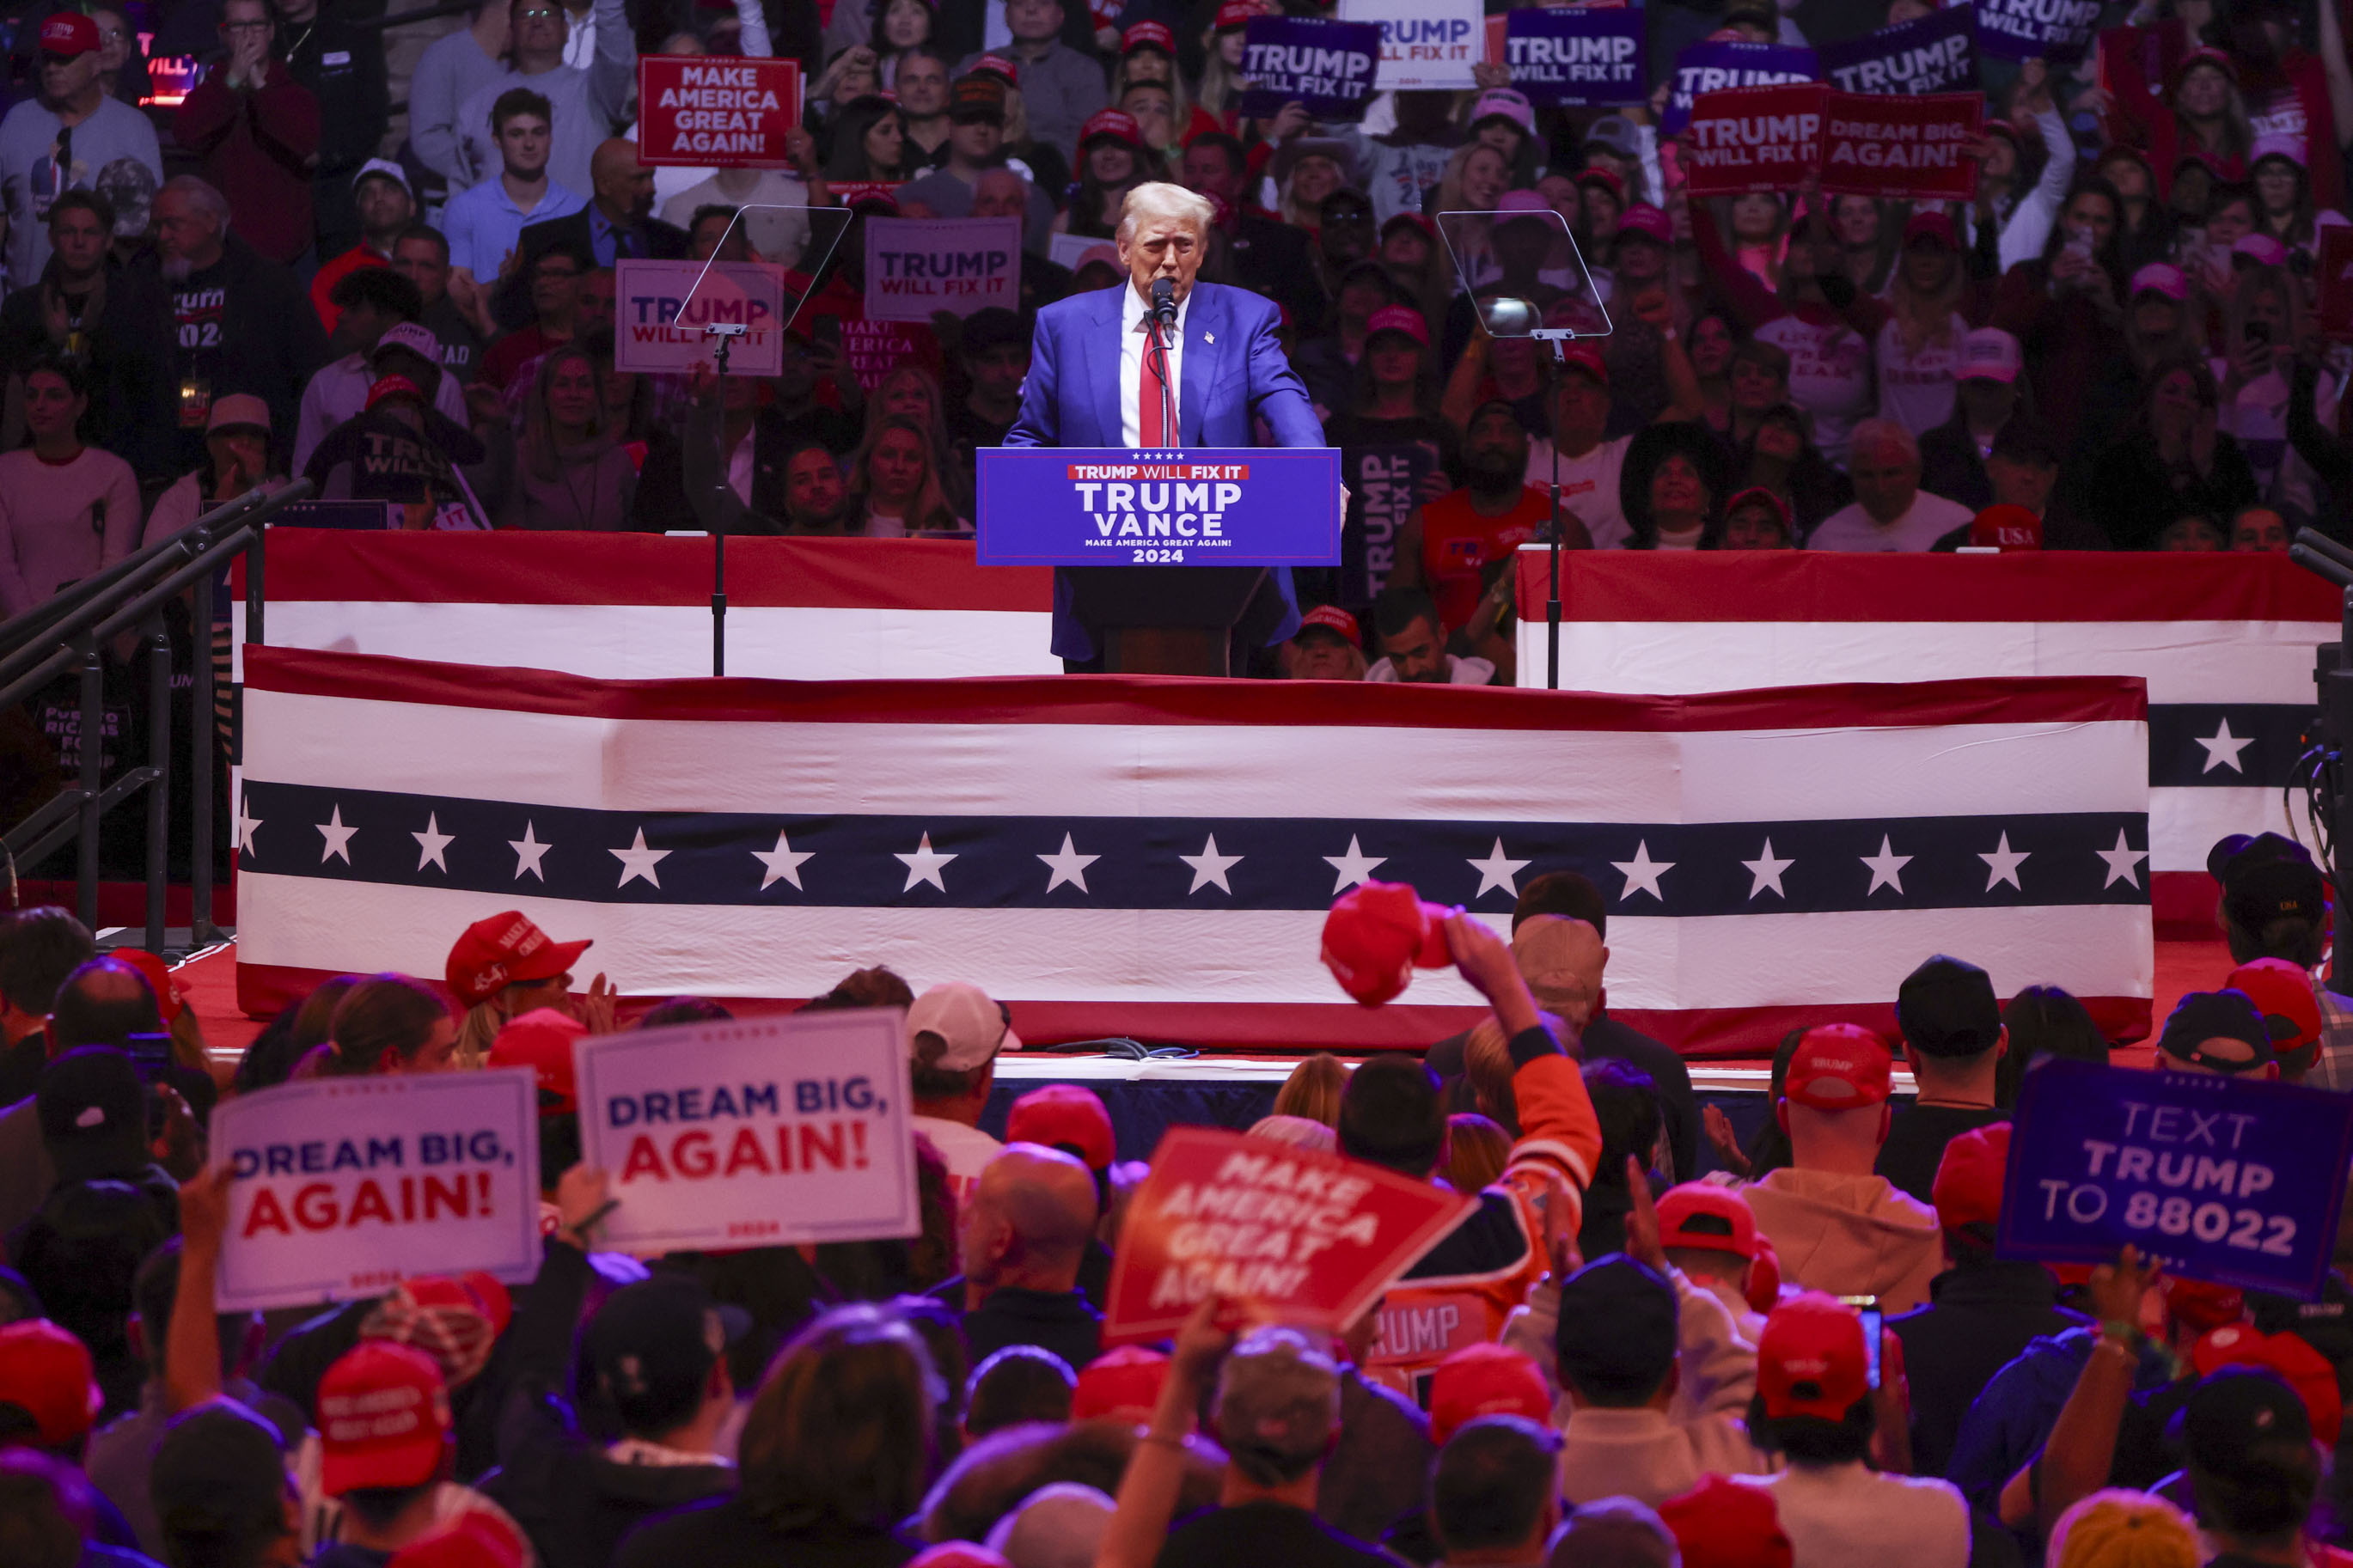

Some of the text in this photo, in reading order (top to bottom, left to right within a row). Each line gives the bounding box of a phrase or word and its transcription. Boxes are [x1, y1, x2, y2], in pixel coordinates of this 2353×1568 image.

[1379, 20, 1470, 43] RUMP
[1979, 9, 2038, 40] WILL
[1248, 44, 1372, 79] TRUMP
[1410, 46, 1442, 60] FIX
[1450, 46, 1470, 60] IT
[1507, 36, 1636, 64] TRUMP
[681, 66, 758, 88] MAKE
[1510, 63, 1636, 82] WILL FIX IT
[1830, 34, 1969, 94] TRUMP
[658, 88, 780, 110] AMERICA
[1299, 75, 1337, 95] FIX
[1341, 80, 1367, 99] IT
[674, 110, 765, 131] GREAT
[1693, 113, 1820, 147] TRUMP
[1830, 119, 1919, 140] DREAM
[671, 132, 766, 153] AGAIN!
[1694, 145, 1754, 166] WILL
[1757, 143, 1795, 163] FIX
[1830, 142, 1959, 168] AGAIN!
[879, 251, 1007, 278] TRUMP
[879, 277, 1004, 296] WILL FIX IT
[632, 296, 768, 324] TRUMP
[175, 322, 223, 348] 02
[633, 326, 694, 344] WILL
[746, 328, 766, 345] IT
[849, 338, 914, 352] ERICA
[1075, 466, 1242, 479] TRUMP WILL FIX IT
[1075, 483, 1242, 512] TRUMP
[1390, 455, 1411, 526] FIX IT
[446, 508, 465, 527] IT
[1094, 513, 1223, 537] VANCE
[1361, 455, 1394, 599] TRUMP
[1998, 527, 2034, 545] USA
[1133, 549, 1184, 563] 2024
[46, 708, 119, 723] PUEO
[46, 722, 119, 737] RICS
[2279, 900, 2299, 911] USA
[1811, 1057, 1854, 1071] TRUMP
[607, 1077, 888, 1128] DREAM BIG,
[2123, 1101, 2257, 1150] TEXT
[231, 1130, 514, 1181] DREAM BIG,
[619, 1119, 871, 1186] AGAIN!
[1216, 1150, 1372, 1205] MAKE
[2083, 1138, 2276, 1199] TRUMP
[241, 1170, 493, 1240] AGAIN!
[1158, 1183, 1379, 1248] AMERICA
[2039, 1178, 2297, 1257] TO 88022
[1166, 1222, 1336, 1263] GREAT
[1371, 1303, 1460, 1358] RUMP
